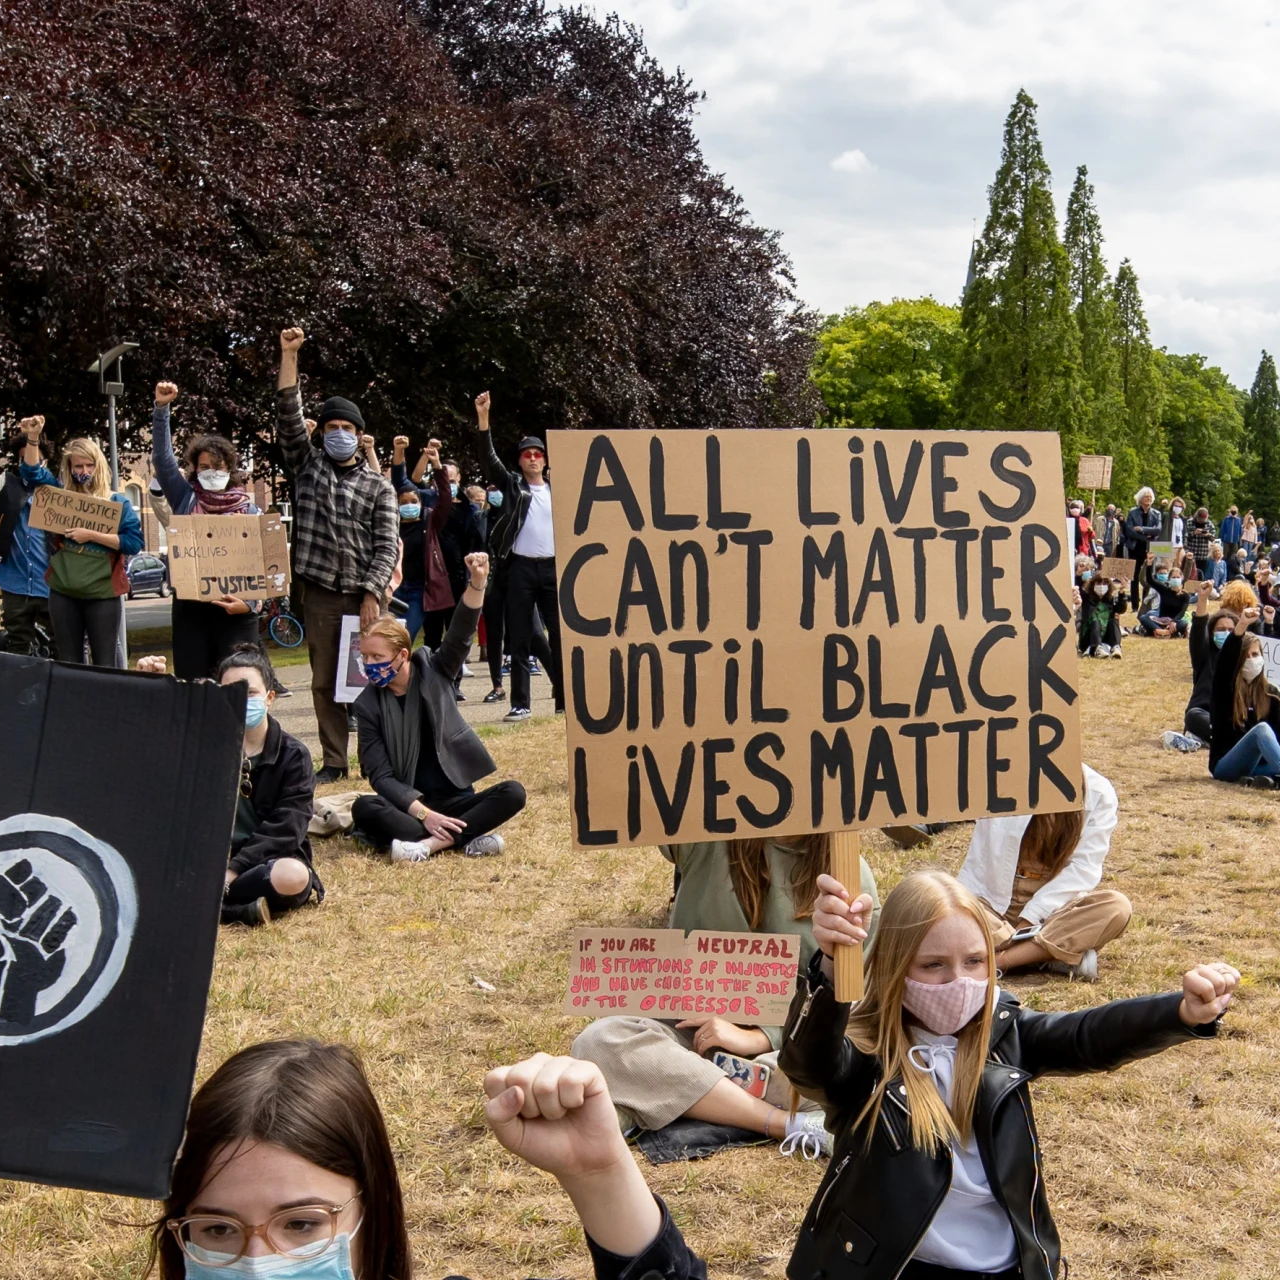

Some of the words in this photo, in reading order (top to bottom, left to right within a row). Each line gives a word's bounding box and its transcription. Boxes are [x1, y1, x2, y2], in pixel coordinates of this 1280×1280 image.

[574, 435, 751, 535] ALL
[51, 493, 73, 508] FOR
[75, 500, 118, 520] JUSTICE
[201, 546, 227, 558] LIVES
[201, 575, 267, 595] JUSTICE
[800, 524, 1071, 630] MATTER
[823, 623, 1078, 723] BLACK
[811, 714, 1076, 828] MATTER
[580, 939, 592, 951] IF
[601, 938, 625, 952] YOU
[629, 938, 656, 952] ARE
[697, 937, 794, 959] NEUTRAL
[580, 957, 596, 973] IN
[602, 957, 693, 974] SITUATIONS
[700, 961, 718, 975] OF
[726, 961, 798, 979] INJUSTICE
[570, 975, 600, 993] YOU
[609, 976, 648, 991] HAVE
[655, 977, 714, 992] CHOSEN
[717, 979, 751, 992] THE
[756, 981, 789, 996] SIDE
[573, 996, 590, 1008] OF
[595, 995, 628, 1008] THE
[640, 996, 760, 1016] OPPRESSOR
